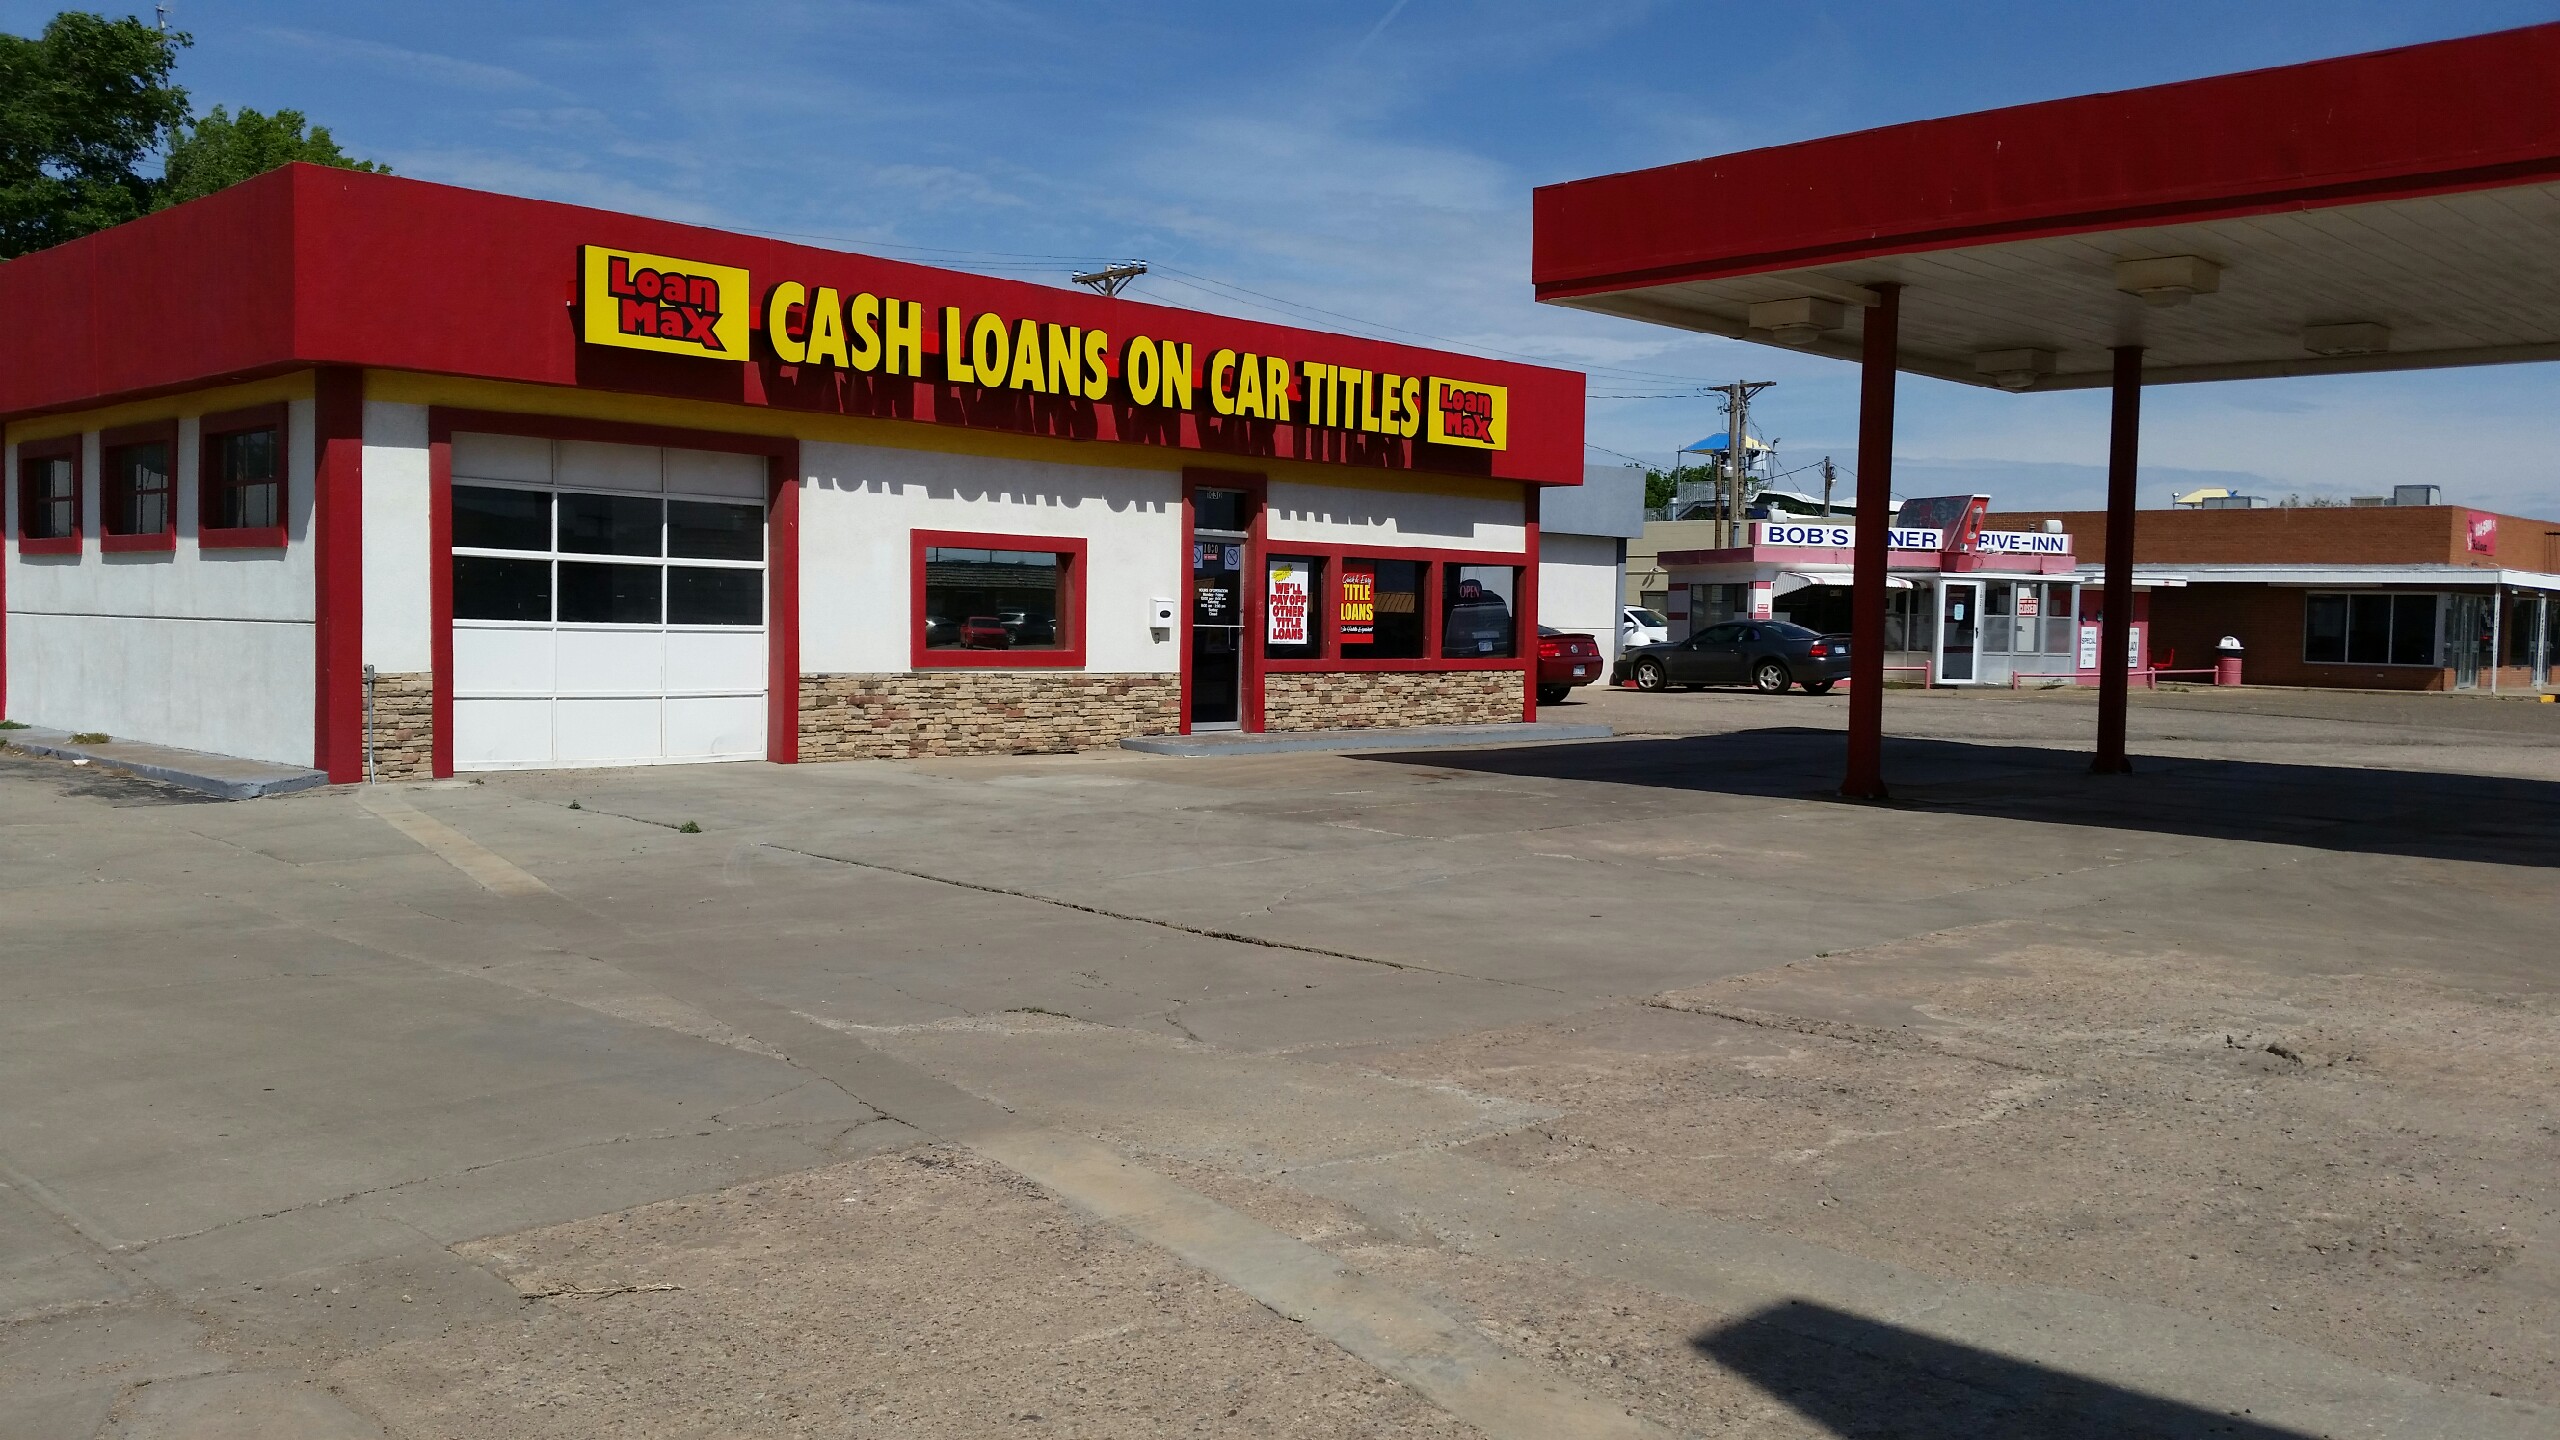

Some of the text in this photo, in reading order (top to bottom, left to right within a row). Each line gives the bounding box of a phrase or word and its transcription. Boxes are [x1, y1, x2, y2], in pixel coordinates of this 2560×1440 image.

[608, 255, 720, 314] Loan
[769, 281, 1420, 438] CASH LOANS ON CAR TITLES
[1439, 383, 1492, 419] Loan
[1768, 526, 1937, 547] BOB'S NER
[1978, 533, 2064, 551] RIVE-INN
[1275, 582, 1303, 594] WE'LL
[1343, 584, 1371, 600] TITLE
[1459, 586, 1480, 598] OPEN
[1272, 605, 1304, 617] OTHER
[1340, 602, 1374, 621] LOANS
[1276, 617, 1302, 628] TITLE
[1273, 628, 1303, 640] LOANS
